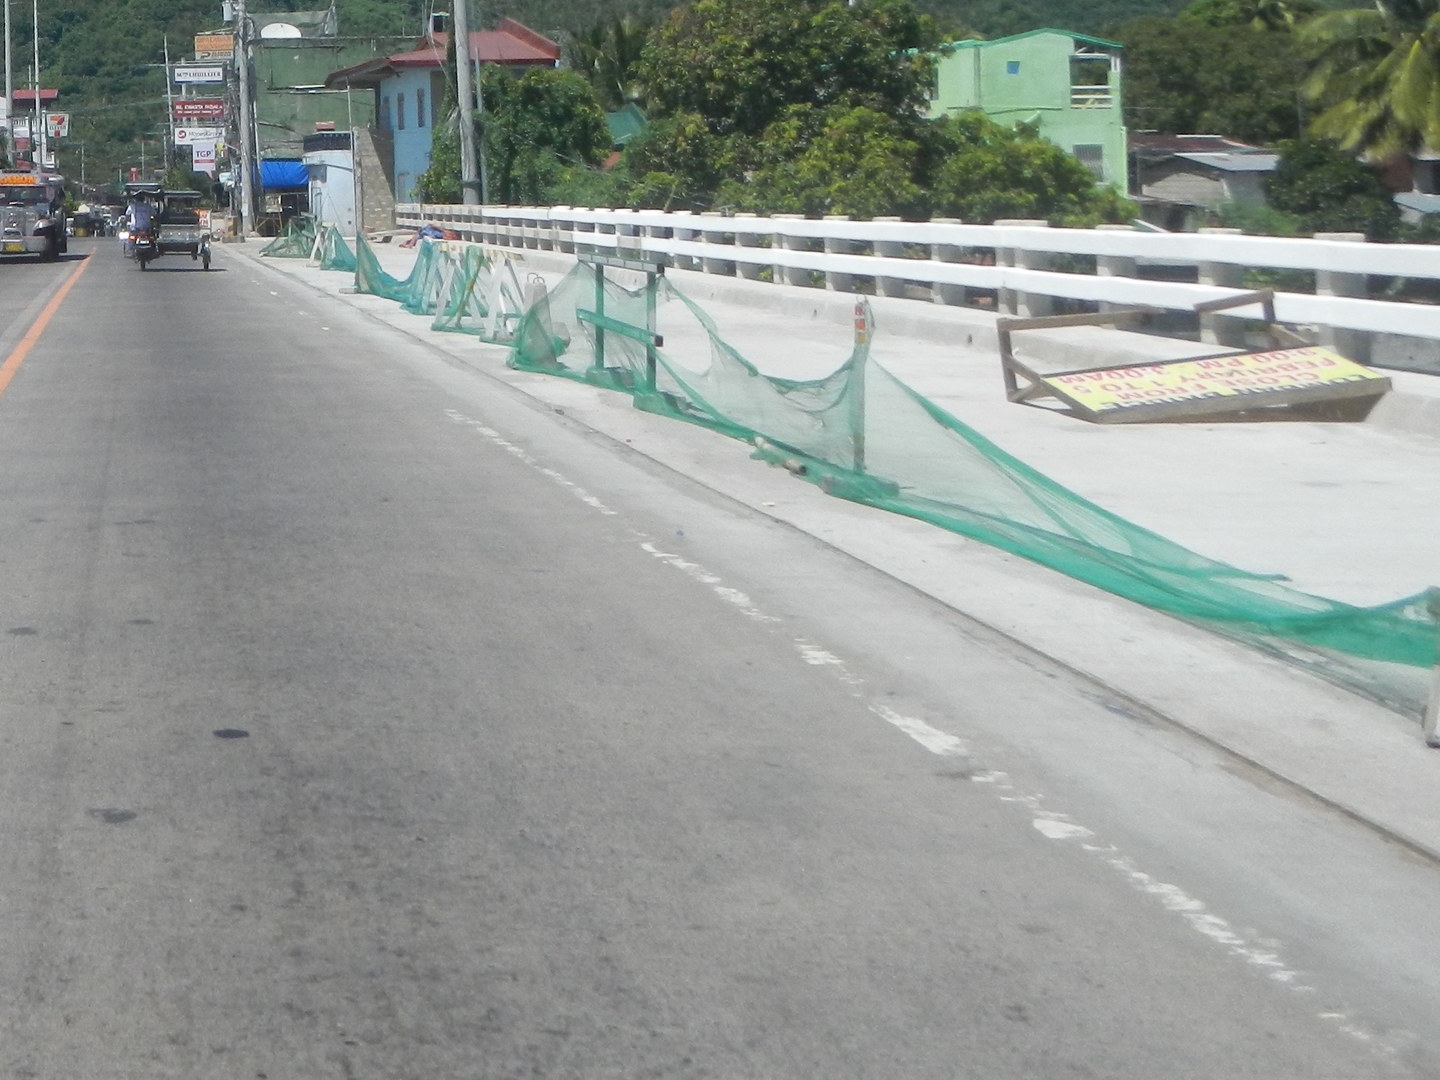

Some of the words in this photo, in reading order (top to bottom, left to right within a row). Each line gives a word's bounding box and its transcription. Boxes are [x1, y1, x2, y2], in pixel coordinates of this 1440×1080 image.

[1178, 358, 1336, 383] FEBRUARY
[1194, 358, 1245, 370] PM
[1100, 383, 1143, 392] TO
[1213, 371, 1319, 388] CLOSE
[1116, 383, 1207, 400] FROM
